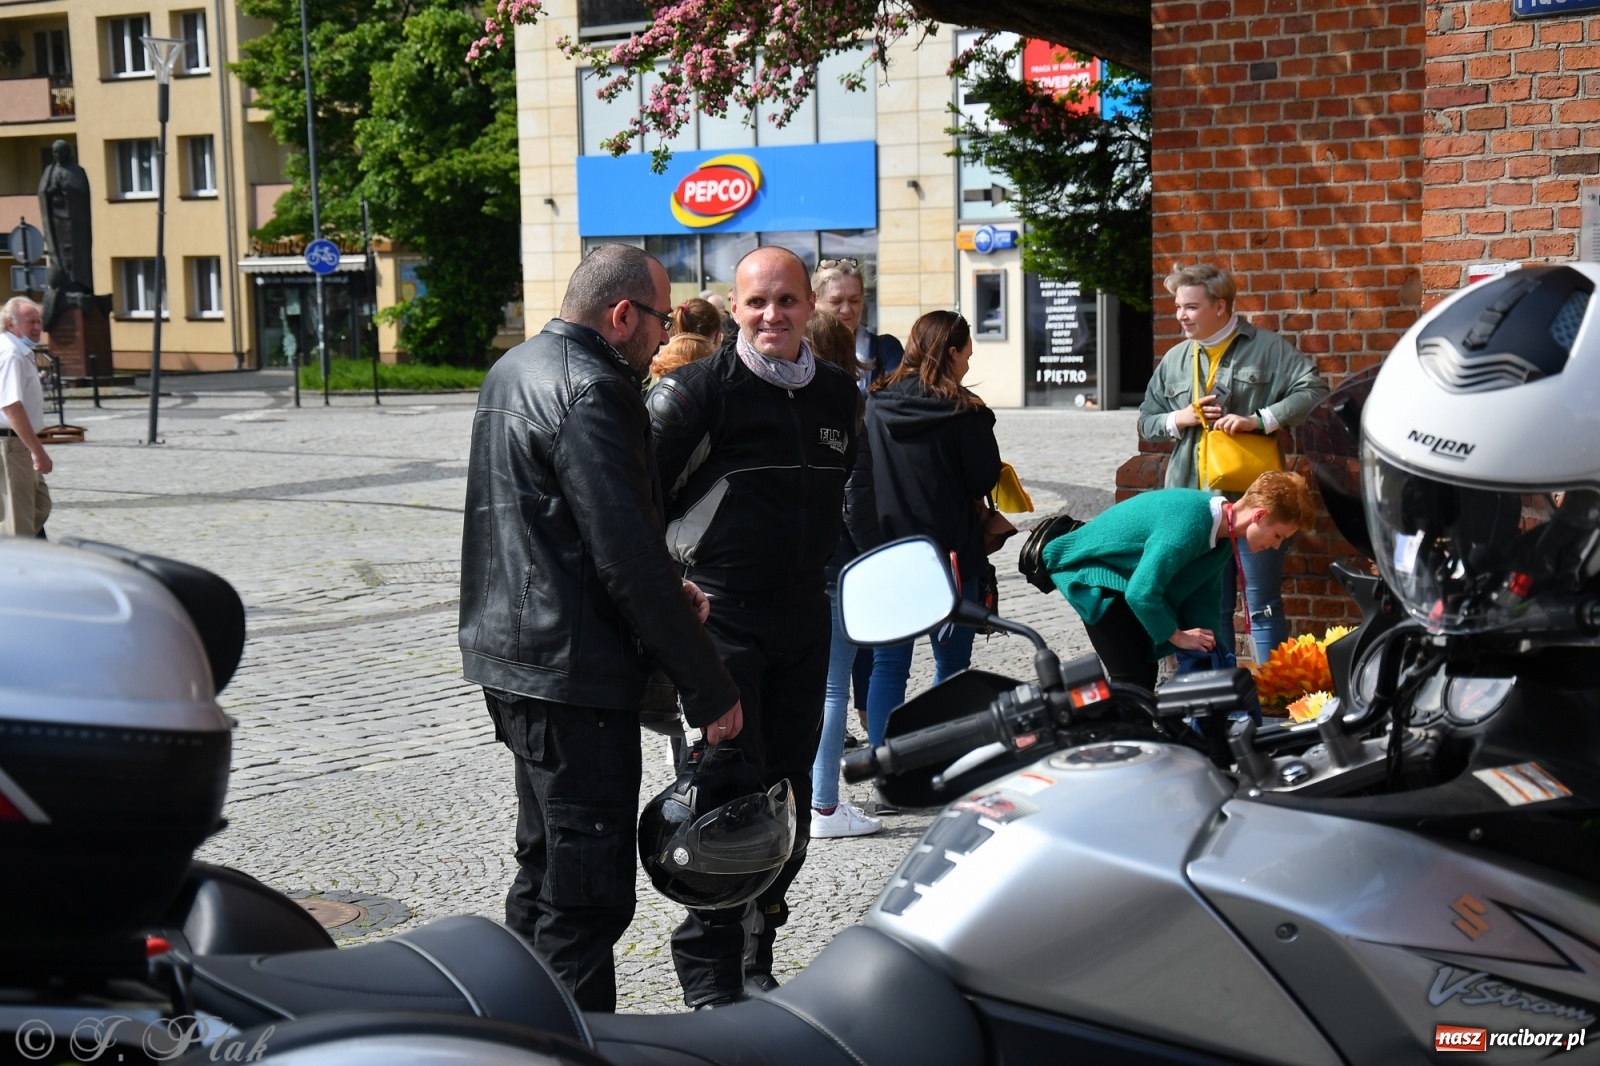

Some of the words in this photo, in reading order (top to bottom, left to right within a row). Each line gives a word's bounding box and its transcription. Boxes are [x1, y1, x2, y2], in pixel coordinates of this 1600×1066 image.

[684, 178, 746, 203] PEPCO
[1043, 370, 1087, 385] PIĘTRO
[1408, 430, 1476, 460] NOLAN
